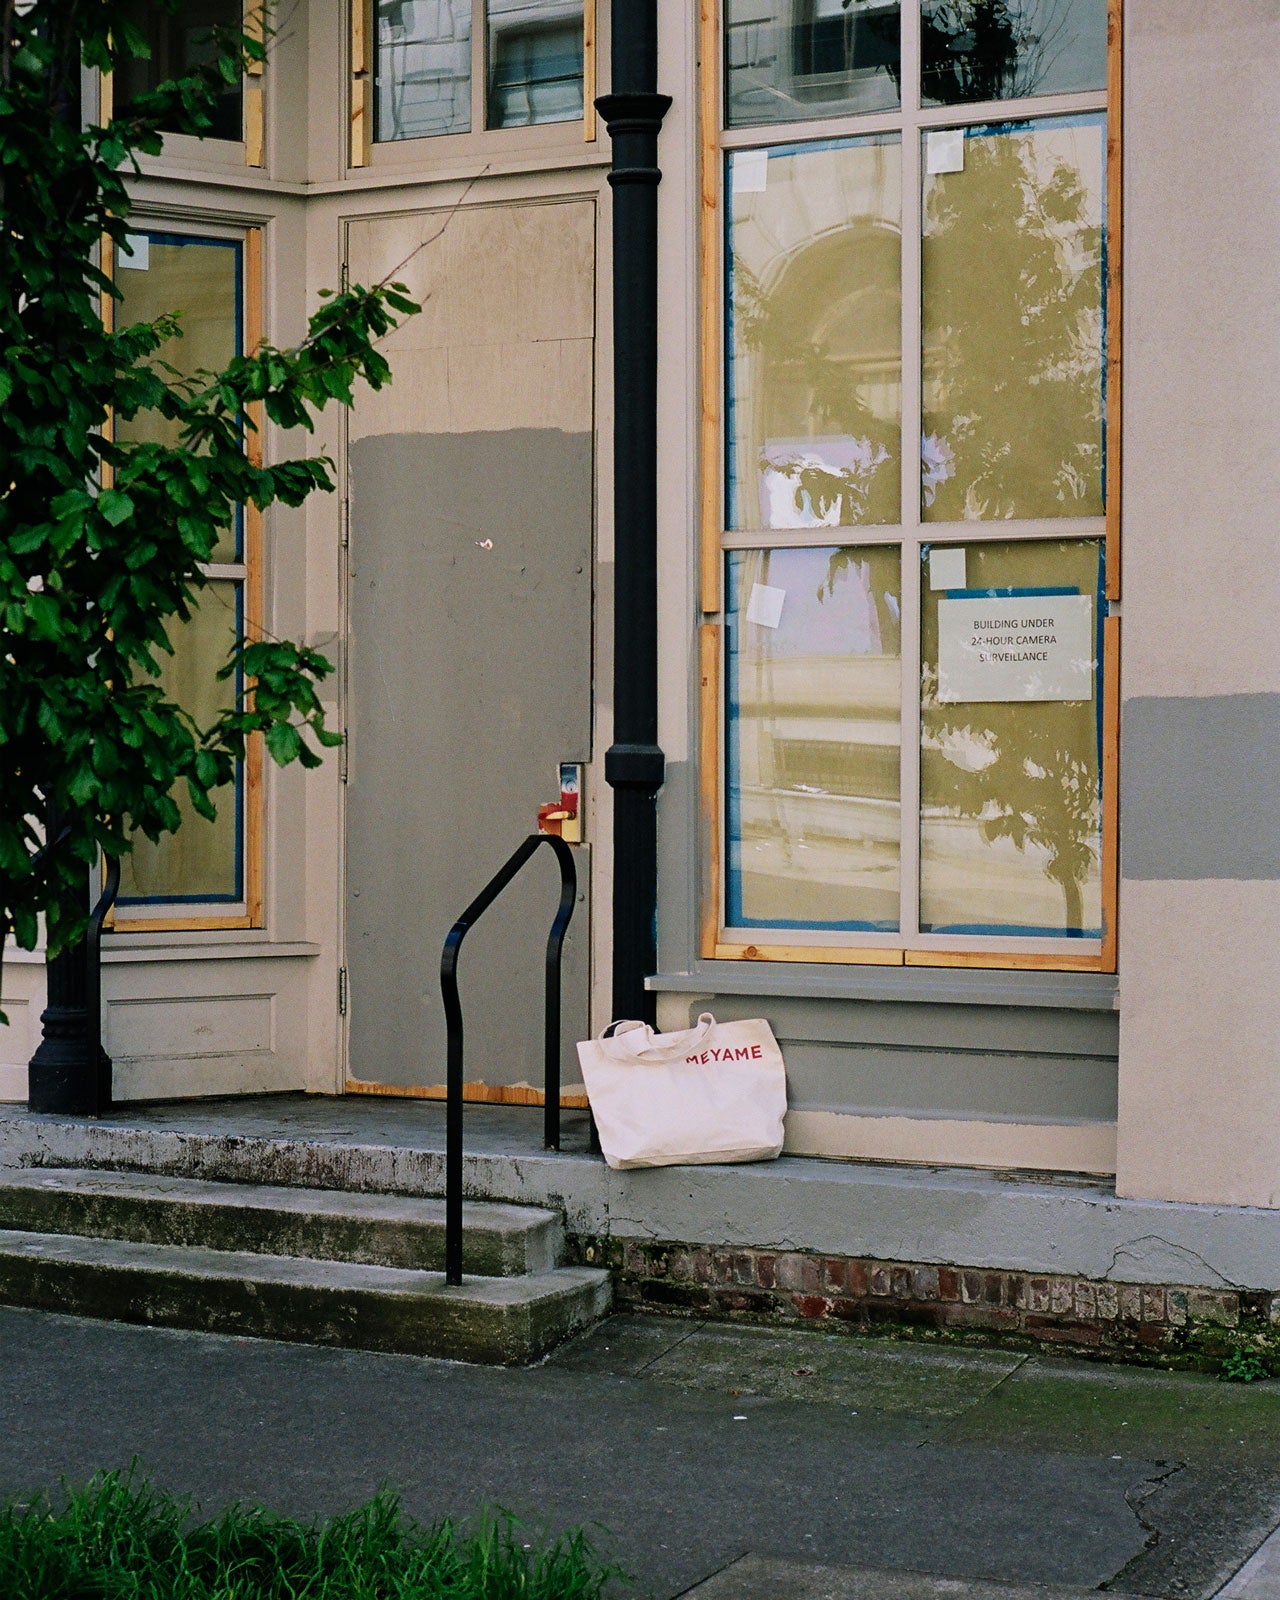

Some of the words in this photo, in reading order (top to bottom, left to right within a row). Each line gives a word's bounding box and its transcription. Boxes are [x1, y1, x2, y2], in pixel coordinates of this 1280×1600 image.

[973, 619, 1018, 629] BUILDING
[1020, 618, 1055, 628] UNDER
[971, 636, 1014, 646] 24-HOUR
[1015, 635, 1057, 645] CAMERA
[685, 1044, 762, 1065] MEYAME
